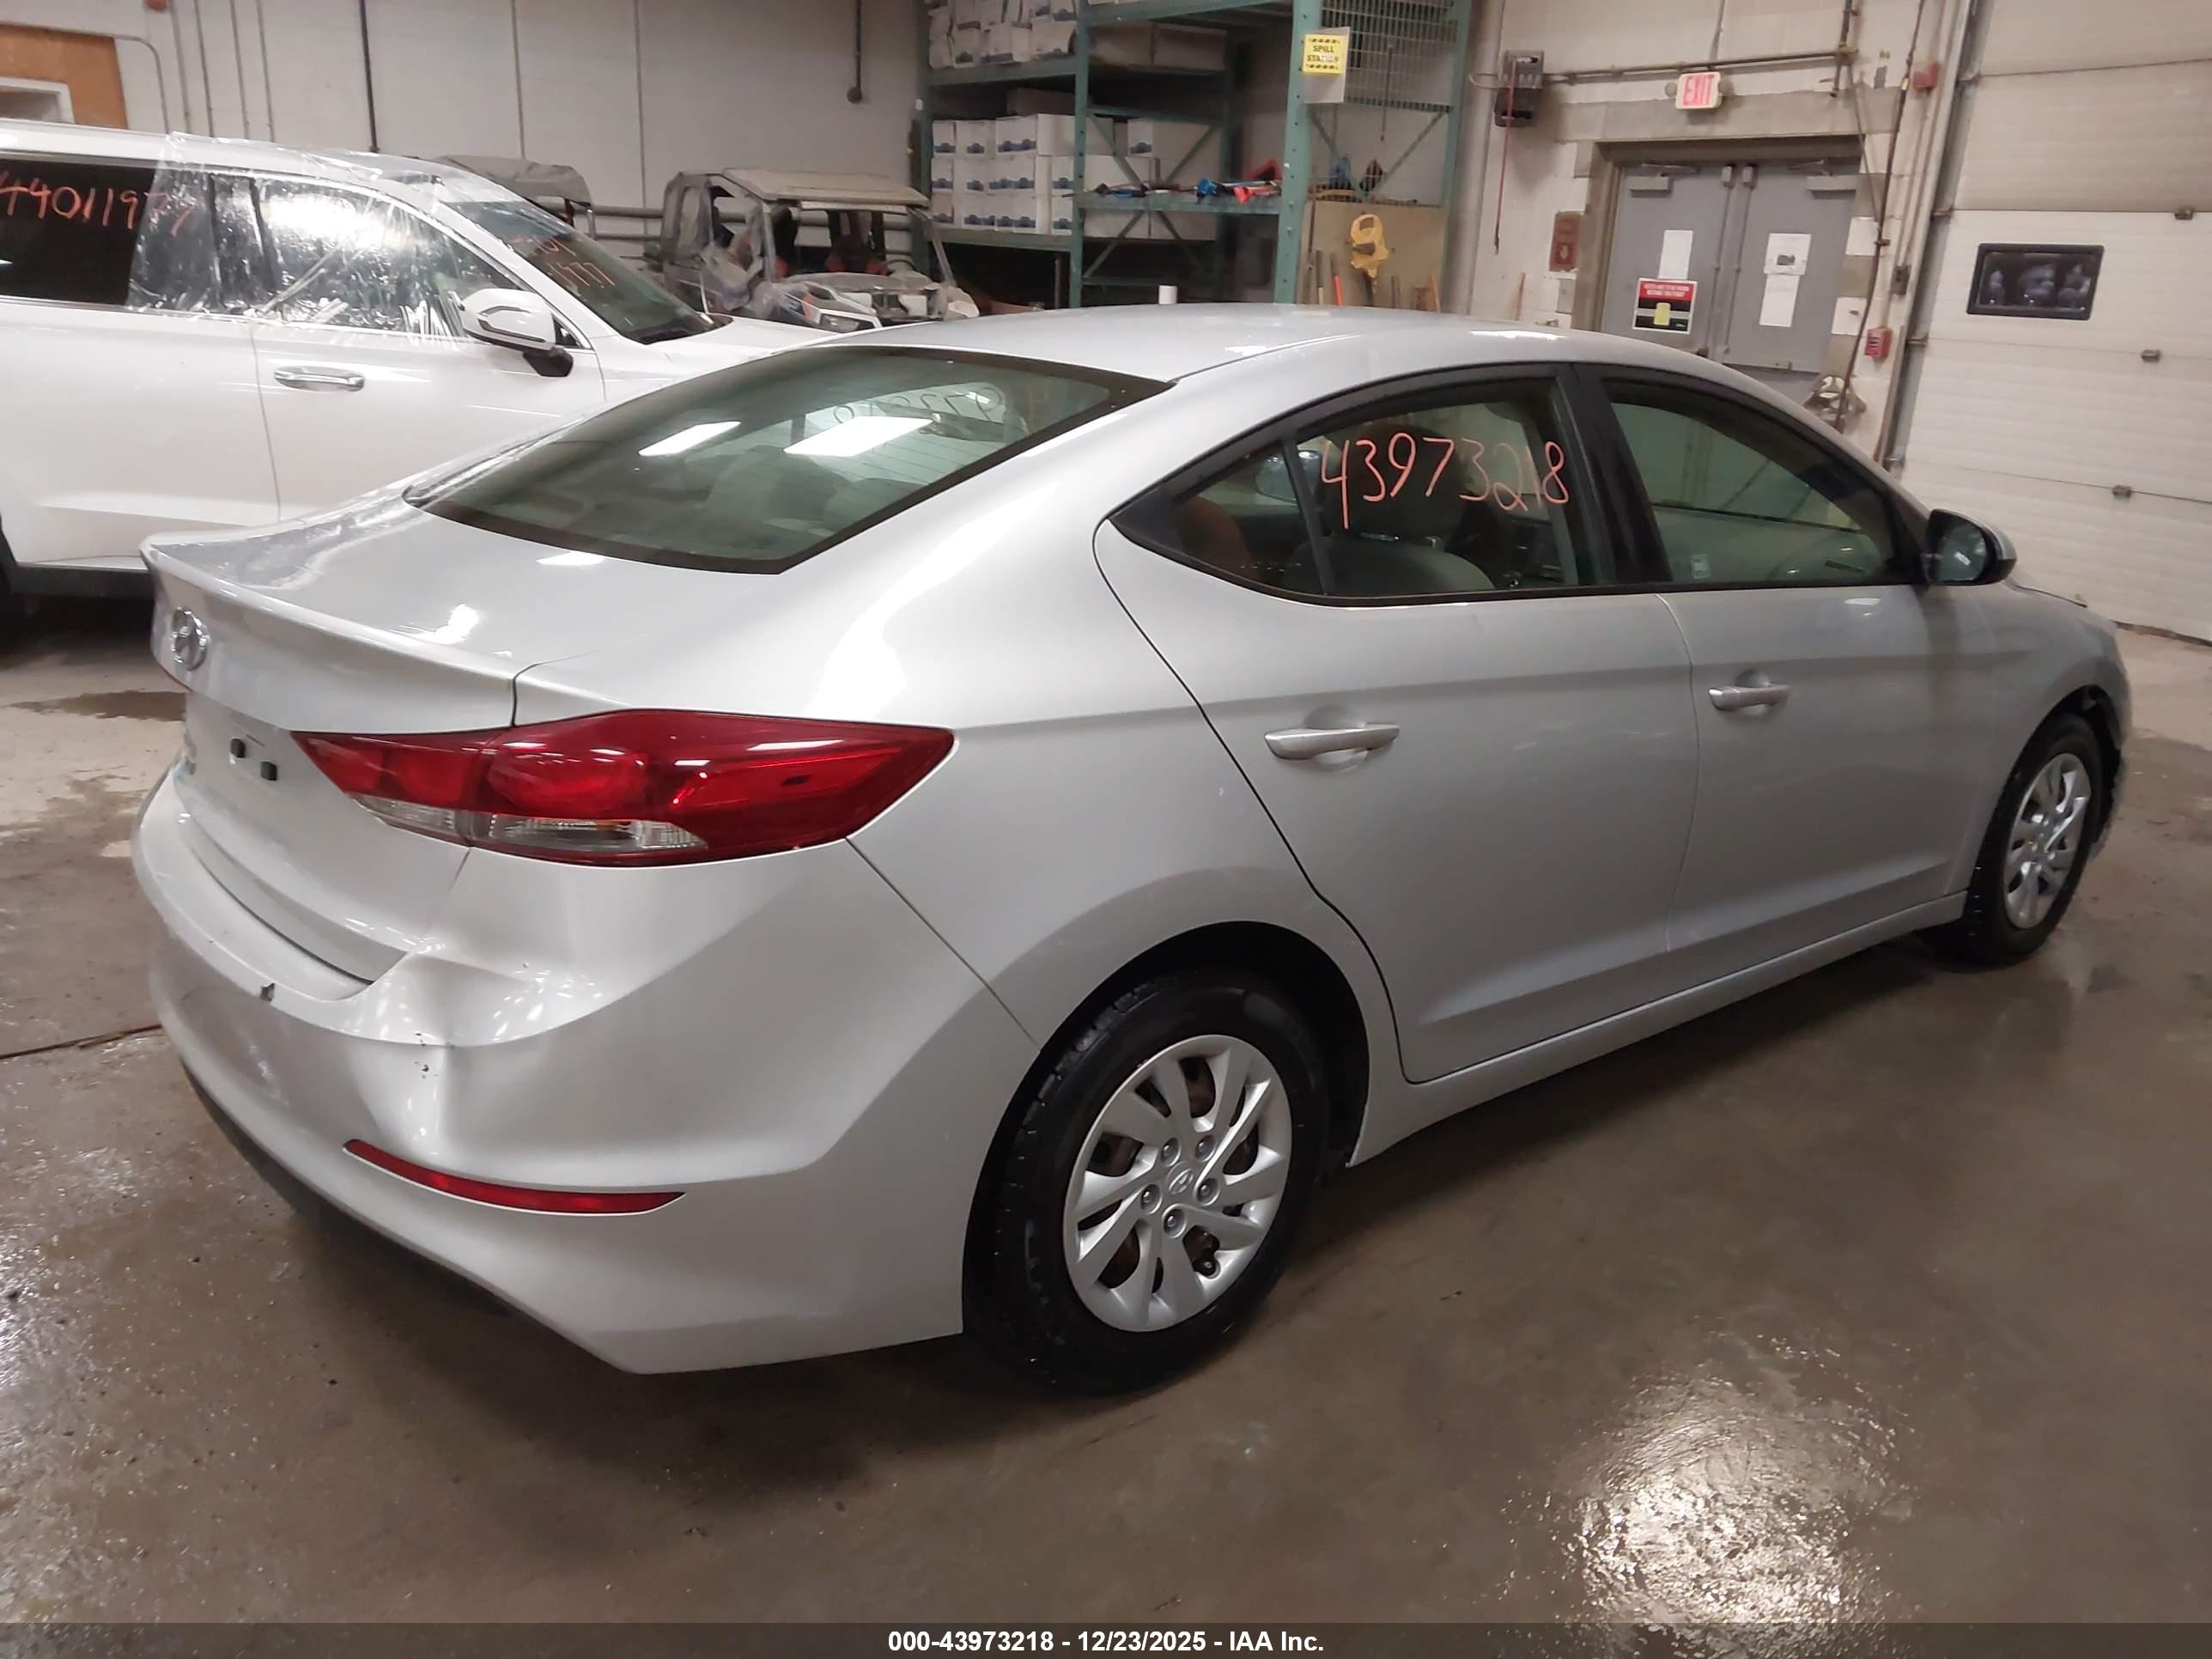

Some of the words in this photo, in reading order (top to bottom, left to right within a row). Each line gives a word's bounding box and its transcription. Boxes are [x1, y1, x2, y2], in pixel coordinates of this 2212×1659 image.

[1312, 45, 1334, 53] SPILL
[1682, 74, 1716, 106] EXIT
[1321, 432, 1570, 530] 43973218
